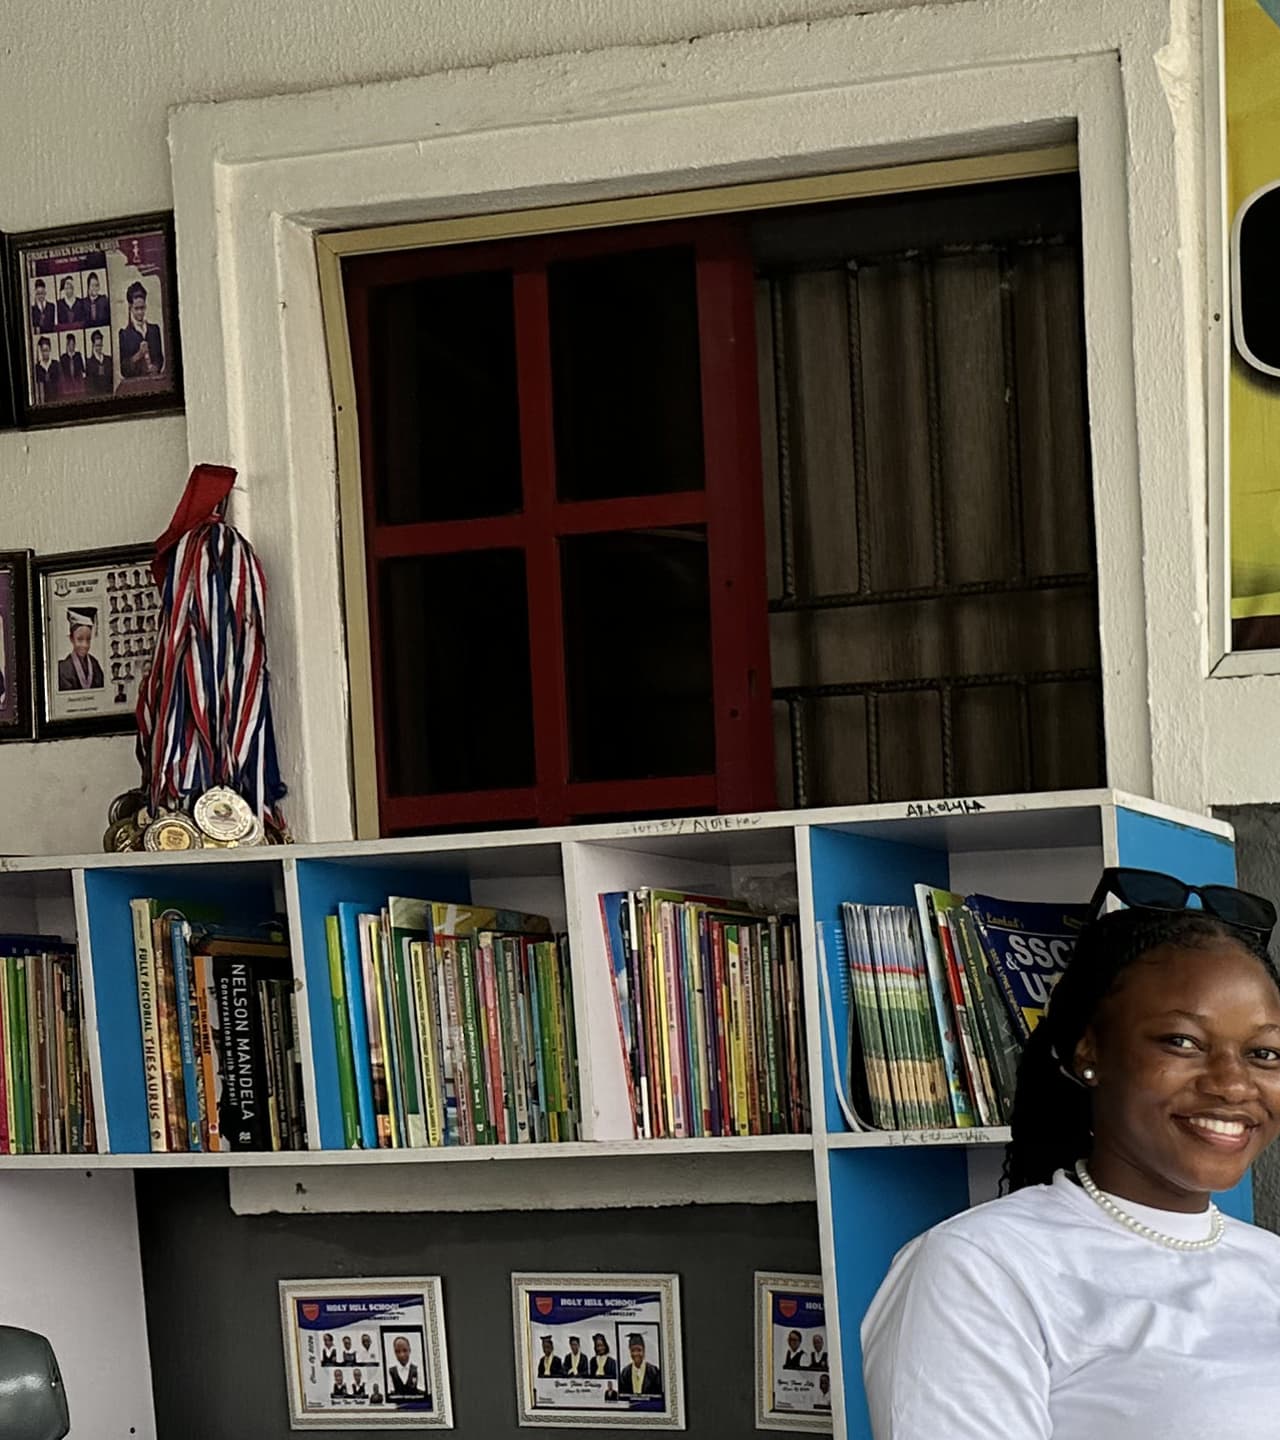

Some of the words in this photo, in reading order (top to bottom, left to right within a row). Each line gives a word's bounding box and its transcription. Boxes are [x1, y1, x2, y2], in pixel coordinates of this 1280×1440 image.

[138, 948, 149, 976] FULLY
[1005, 952, 1021, 971] &
[1008, 934, 1078, 969] SSC
[141, 980, 153, 1032] PICTORIAL
[220, 977, 233, 1046] Conversations
[231, 964, 250, 1031] NELSON
[144, 1036, 160, 1120] THESAURUS
[226, 1050, 235, 1071] with
[228, 1074, 238, 1106] Myself
[236, 1038, 255, 1120] MANDELA
[805, 1302, 824, 1310] HOL
